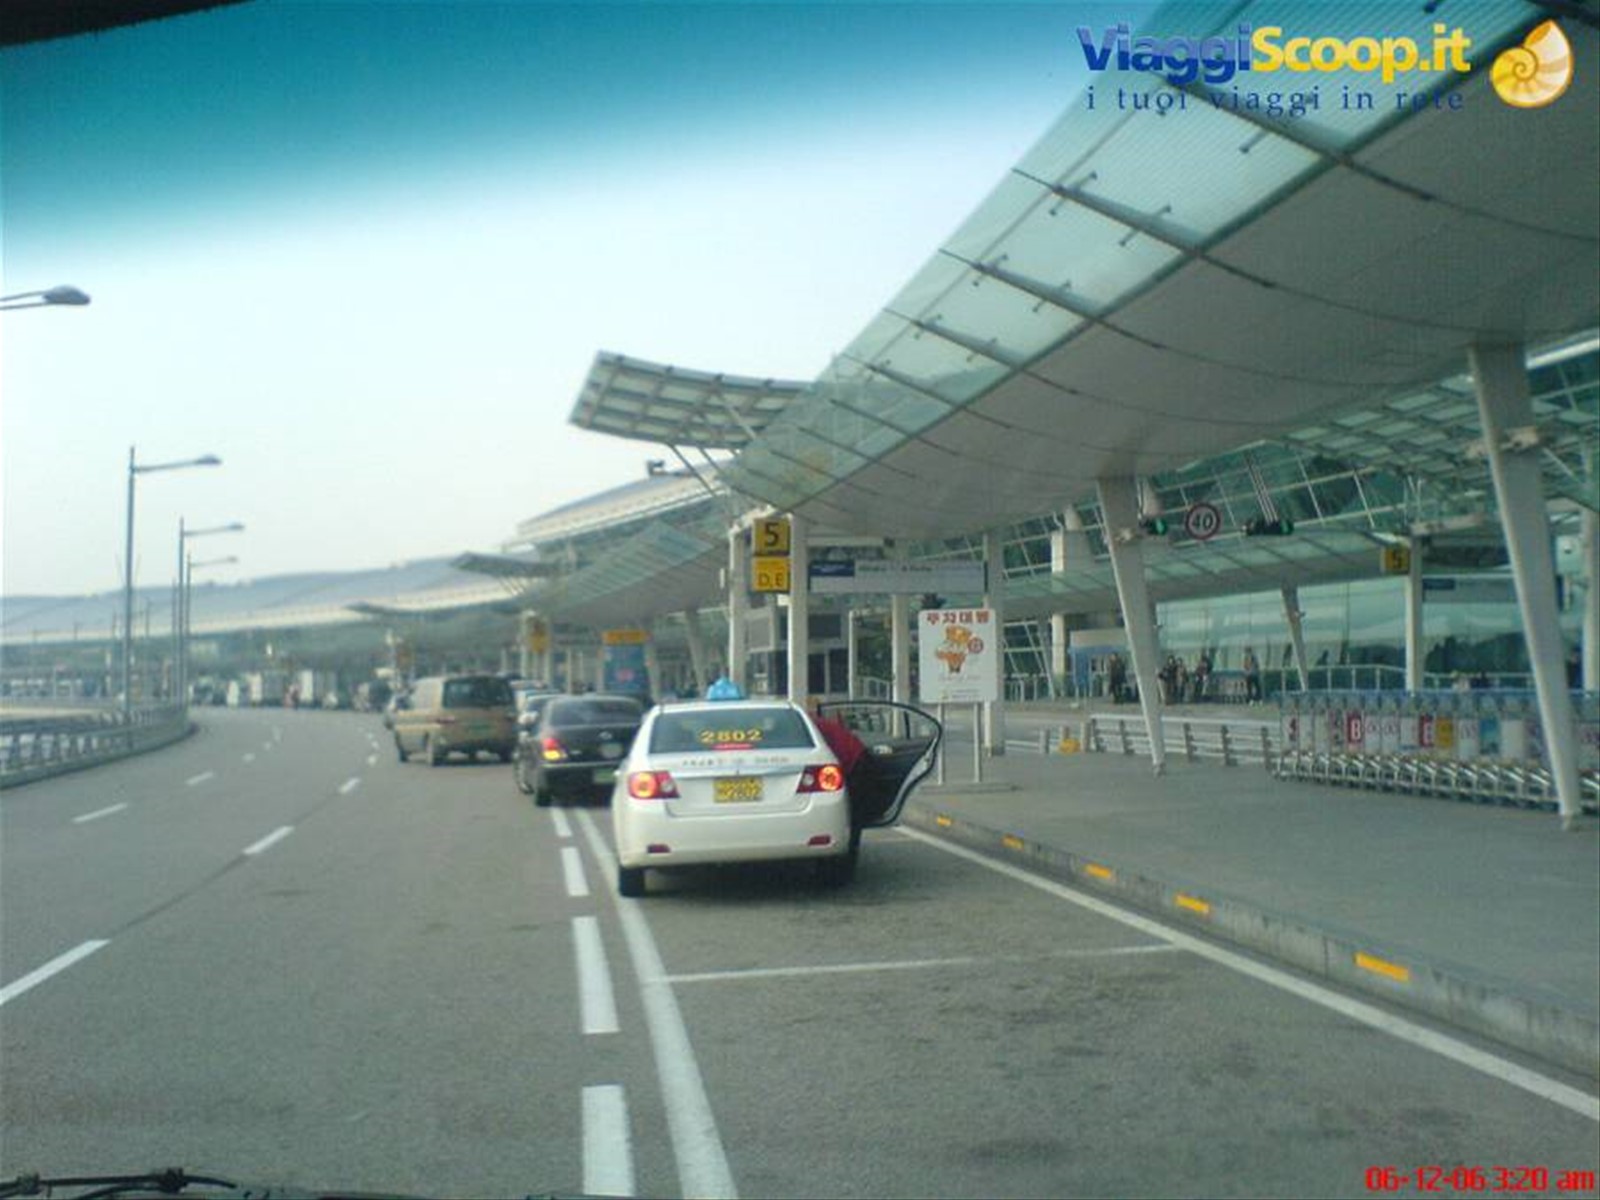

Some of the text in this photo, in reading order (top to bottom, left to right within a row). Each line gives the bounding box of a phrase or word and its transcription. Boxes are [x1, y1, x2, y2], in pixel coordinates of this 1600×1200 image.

[1191, 513, 1213, 530] 40
[764, 521, 779, 547] 5
[700, 727, 763, 744] 2802
